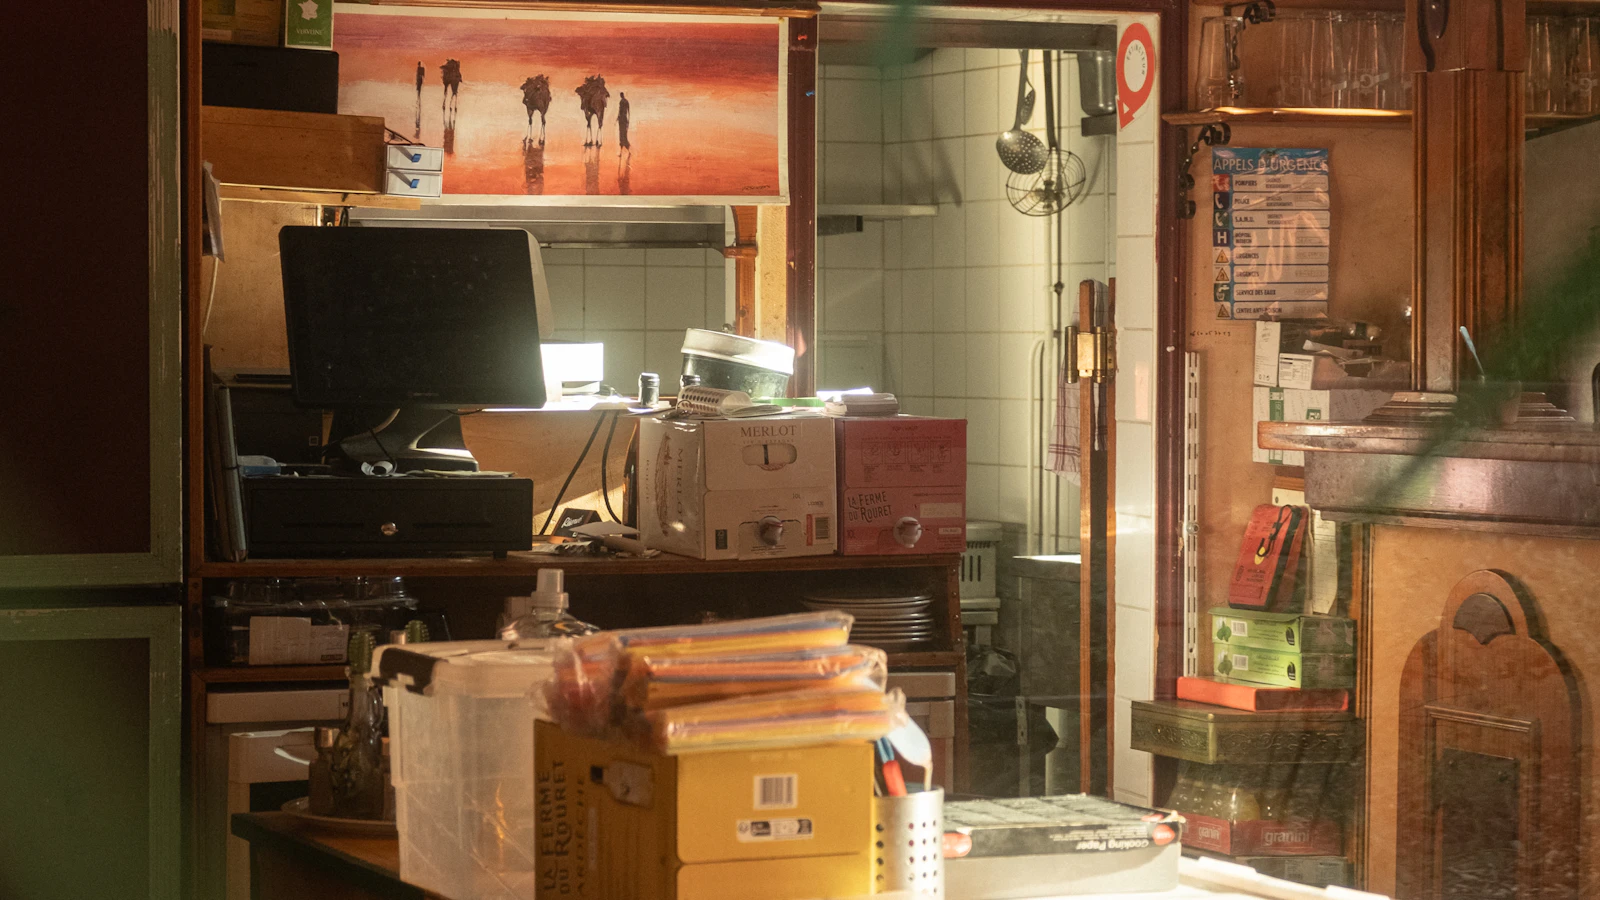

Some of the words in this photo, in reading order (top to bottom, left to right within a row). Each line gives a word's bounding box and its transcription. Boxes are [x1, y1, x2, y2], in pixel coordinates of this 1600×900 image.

[1213, 158, 1254, 171] APPELS
[741, 425, 797, 437] MERLOT
[847, 496, 859, 509] LA
[859, 491, 886, 507] FERME
[849, 511, 859, 521] DU
[860, 504, 893, 523] ROURET
[538, 771, 554, 857] FERME
[553, 760, 572, 857] ROURET
[1108, 839, 1149, 850] Cooking
[1264, 827, 1310, 846] granini
[1076, 841, 1106, 851] Paper
[543, 861, 557, 891] LA
